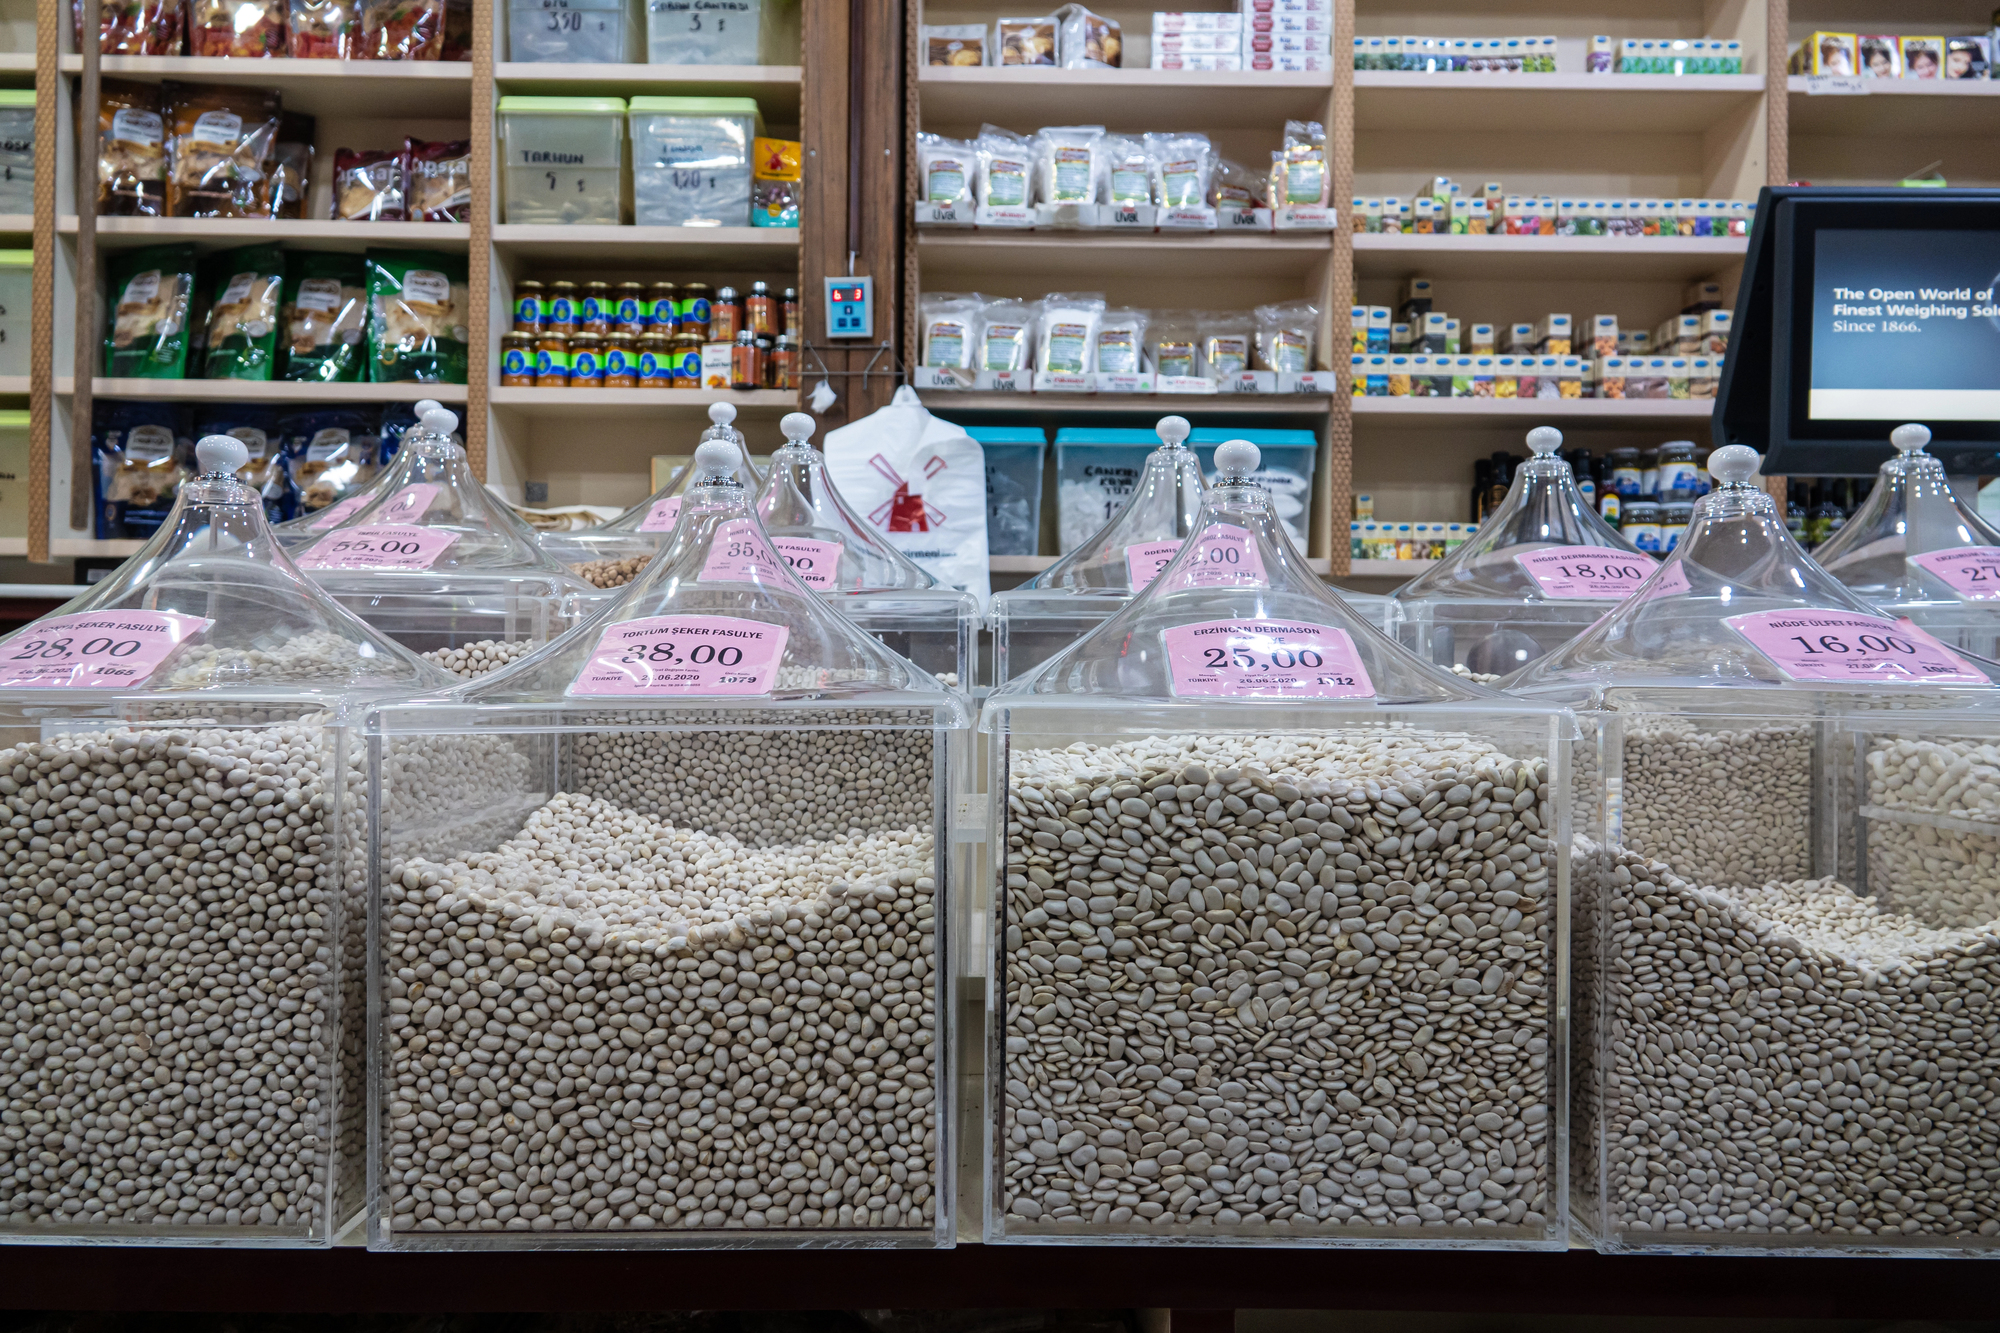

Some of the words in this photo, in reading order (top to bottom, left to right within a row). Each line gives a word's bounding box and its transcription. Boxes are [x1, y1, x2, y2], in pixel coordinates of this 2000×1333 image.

[521, 151, 584, 164] TARHUN
[1833, 287, 1865, 300] The
[1868, 287, 1915, 302] Open
[1919, 287, 1971, 300] World
[1975, 287, 1994, 300] of
[1833, 304, 1883, 316] Finest
[1886, 304, 1967, 319] Weighing
[1833, 320, 1876, 332] Since
[1882, 321, 1922, 332] 1866.
[332, 540, 420, 554] 55,00
[785, 545, 822, 553] FASULYE
[1557, 564, 1642, 580] 18,00
[75, 621, 116, 631] ŞEKER
[115, 623, 171, 634] FASULYE
[1193, 626, 1252, 636] ERZİNCAN
[1254, 626, 1321, 635] DERMASON
[1809, 618, 1845, 628] ÜLFET
[1846, 620, 1898, 632] FASULYE
[622, 627, 669, 639] TORTUM
[671, 627, 710, 637] ŞEKER
[712, 629, 764, 640] FASULYE
[10, 637, 142, 660] 28,00
[1791, 634, 1917, 655] 16,00
[621, 642, 743, 666] 38,00
[1203, 648, 1323, 671] 25,00
[94, 667, 136, 676] 1065
